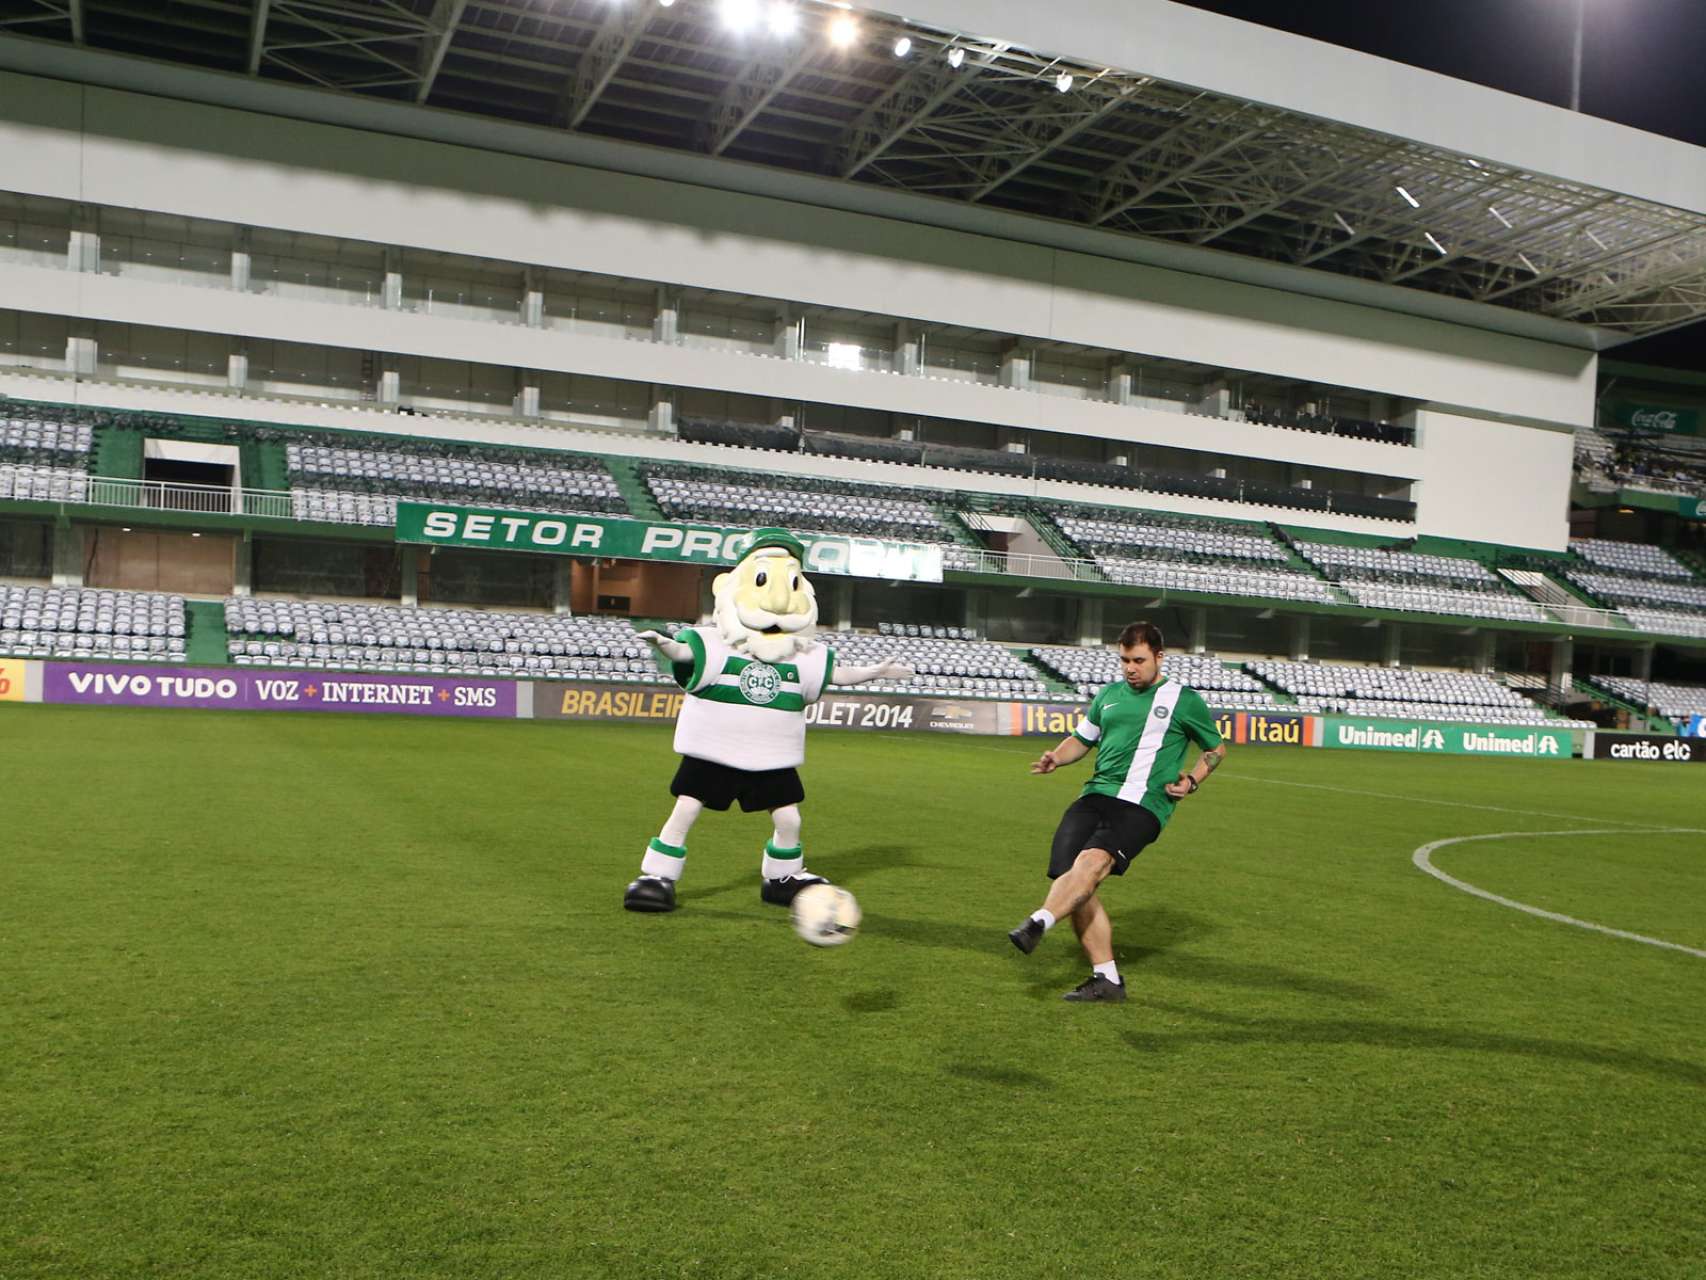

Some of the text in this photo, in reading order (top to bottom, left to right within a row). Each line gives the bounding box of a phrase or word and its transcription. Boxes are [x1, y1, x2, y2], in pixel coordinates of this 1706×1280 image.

[423, 511, 604, 549] SETOR
[68, 672, 237, 698] VIVO TUDO
[256, 678, 299, 701] VOZ
[322, 681, 433, 705] INTERNET
[454, 686, 496, 708] SMS
[861, 703, 913, 728] 2014
[1026, 704, 1084, 734] Itaú
[1250, 716, 1299, 744] Itaú
[1338, 724, 1417, 749] Unimed
[1463, 732, 1534, 755] Unimed
[1610, 740, 1660, 760] cartão
